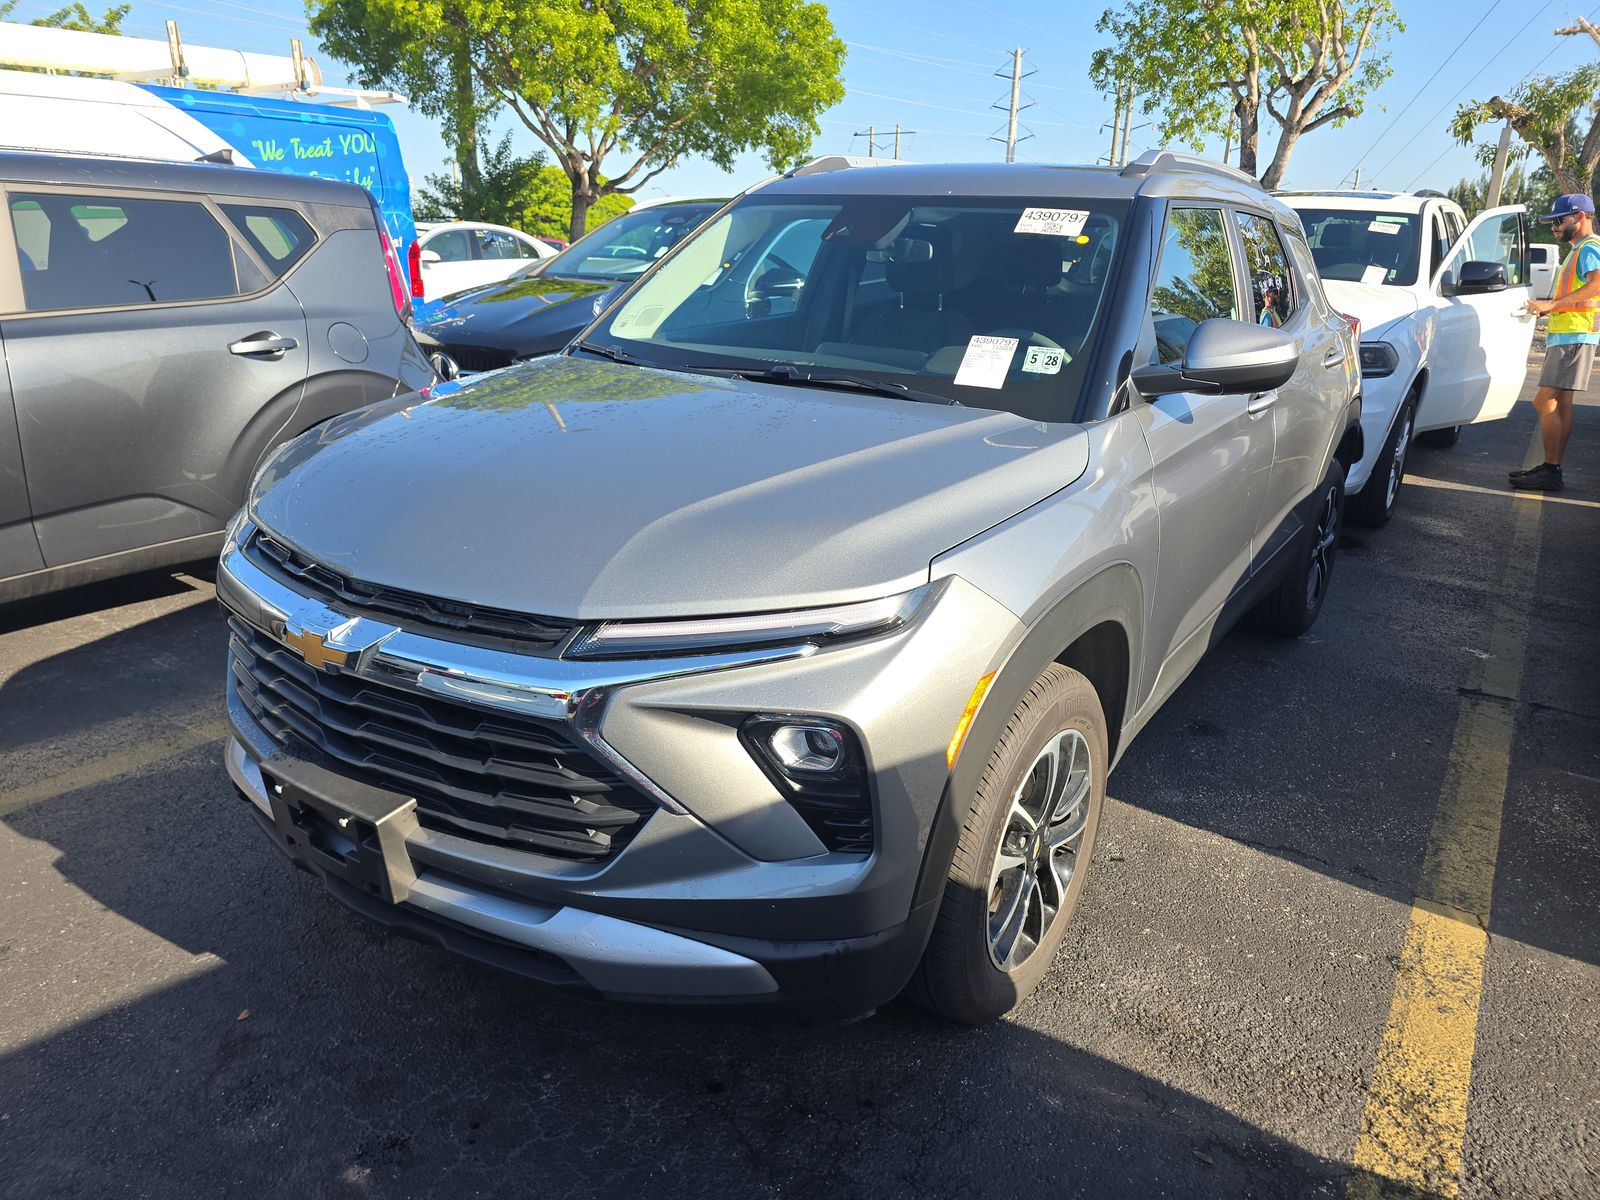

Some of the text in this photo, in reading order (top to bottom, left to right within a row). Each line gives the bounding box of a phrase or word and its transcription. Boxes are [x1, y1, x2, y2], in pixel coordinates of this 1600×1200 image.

[290, 137, 334, 159] Treat
[339, 132, 376, 155] YOU
[1025, 210, 1088, 223] 4390797
[973, 337, 1018, 346] 4390797
[1030, 353, 1059, 367] 5 28
